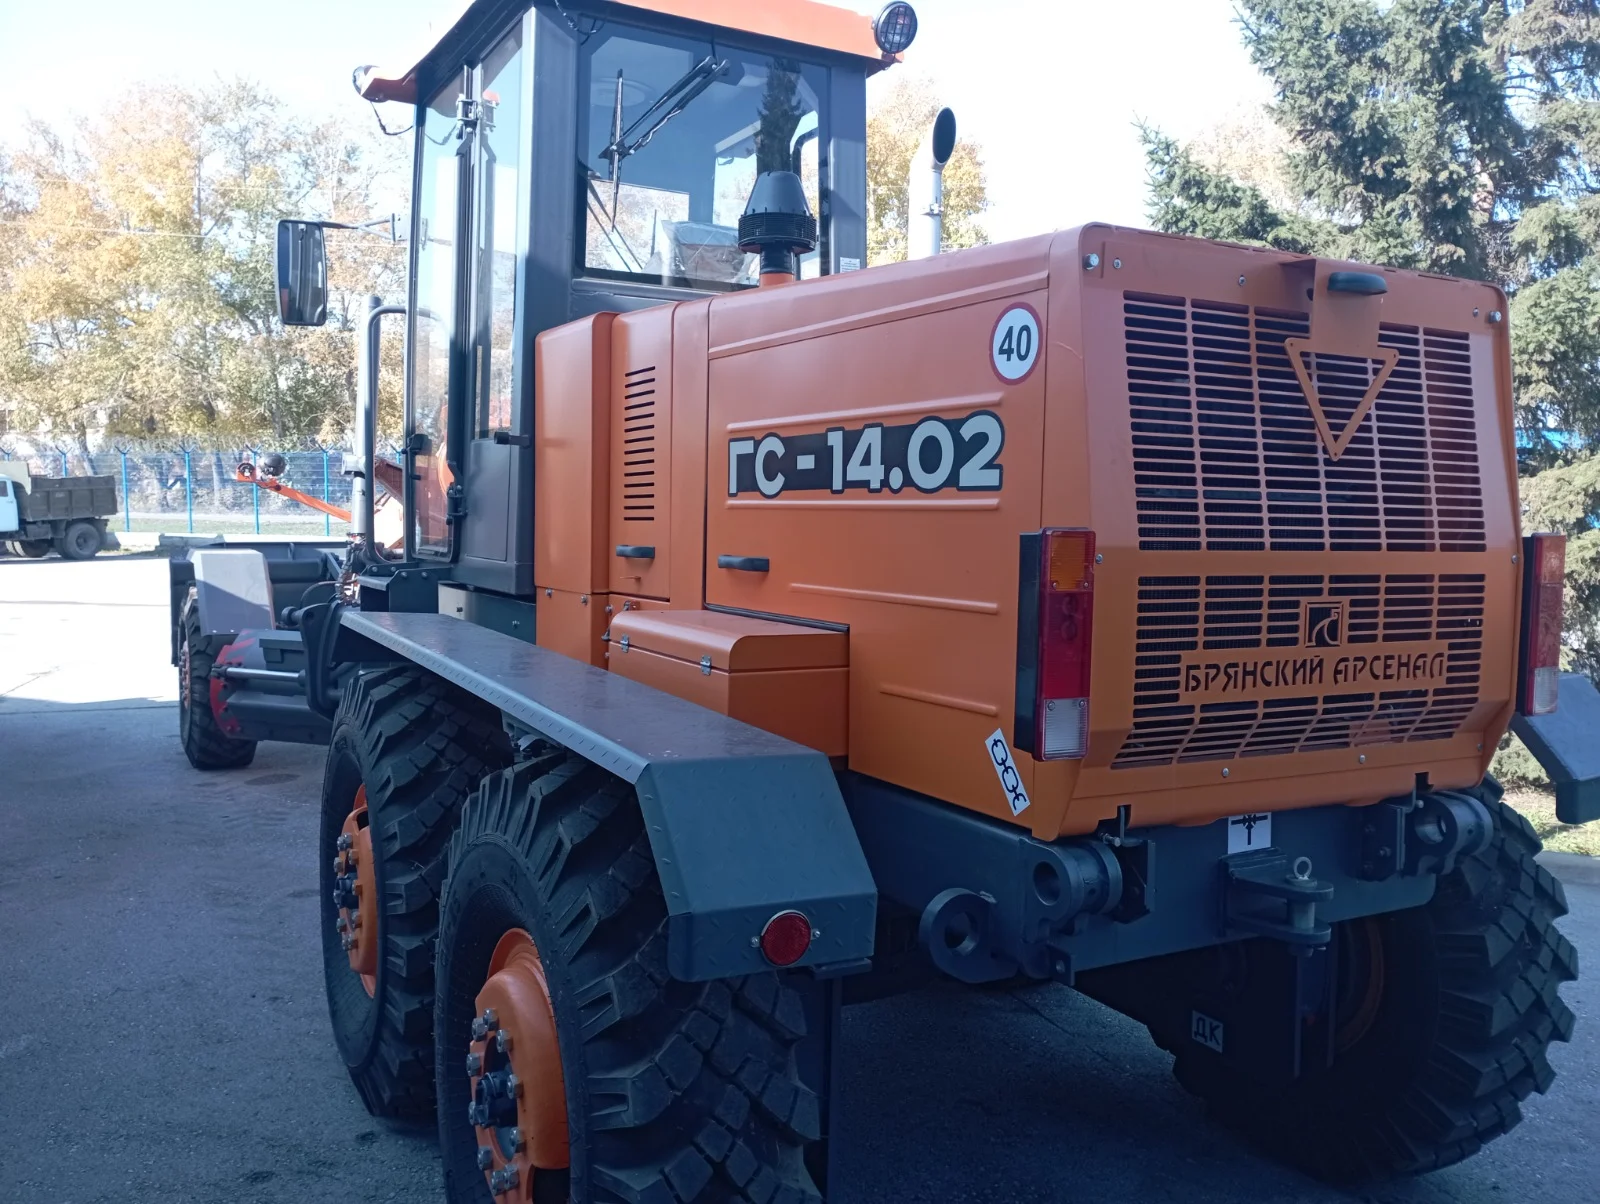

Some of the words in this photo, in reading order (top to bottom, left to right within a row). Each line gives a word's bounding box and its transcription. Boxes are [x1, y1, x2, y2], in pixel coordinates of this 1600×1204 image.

[998, 324, 1031, 361] 40
[1184, 655, 1324, 693] БРЯНСКИЙ
[1333, 652, 1445, 686] АРСЕНАЛ
[1194, 1016, 1221, 1046] ДК
